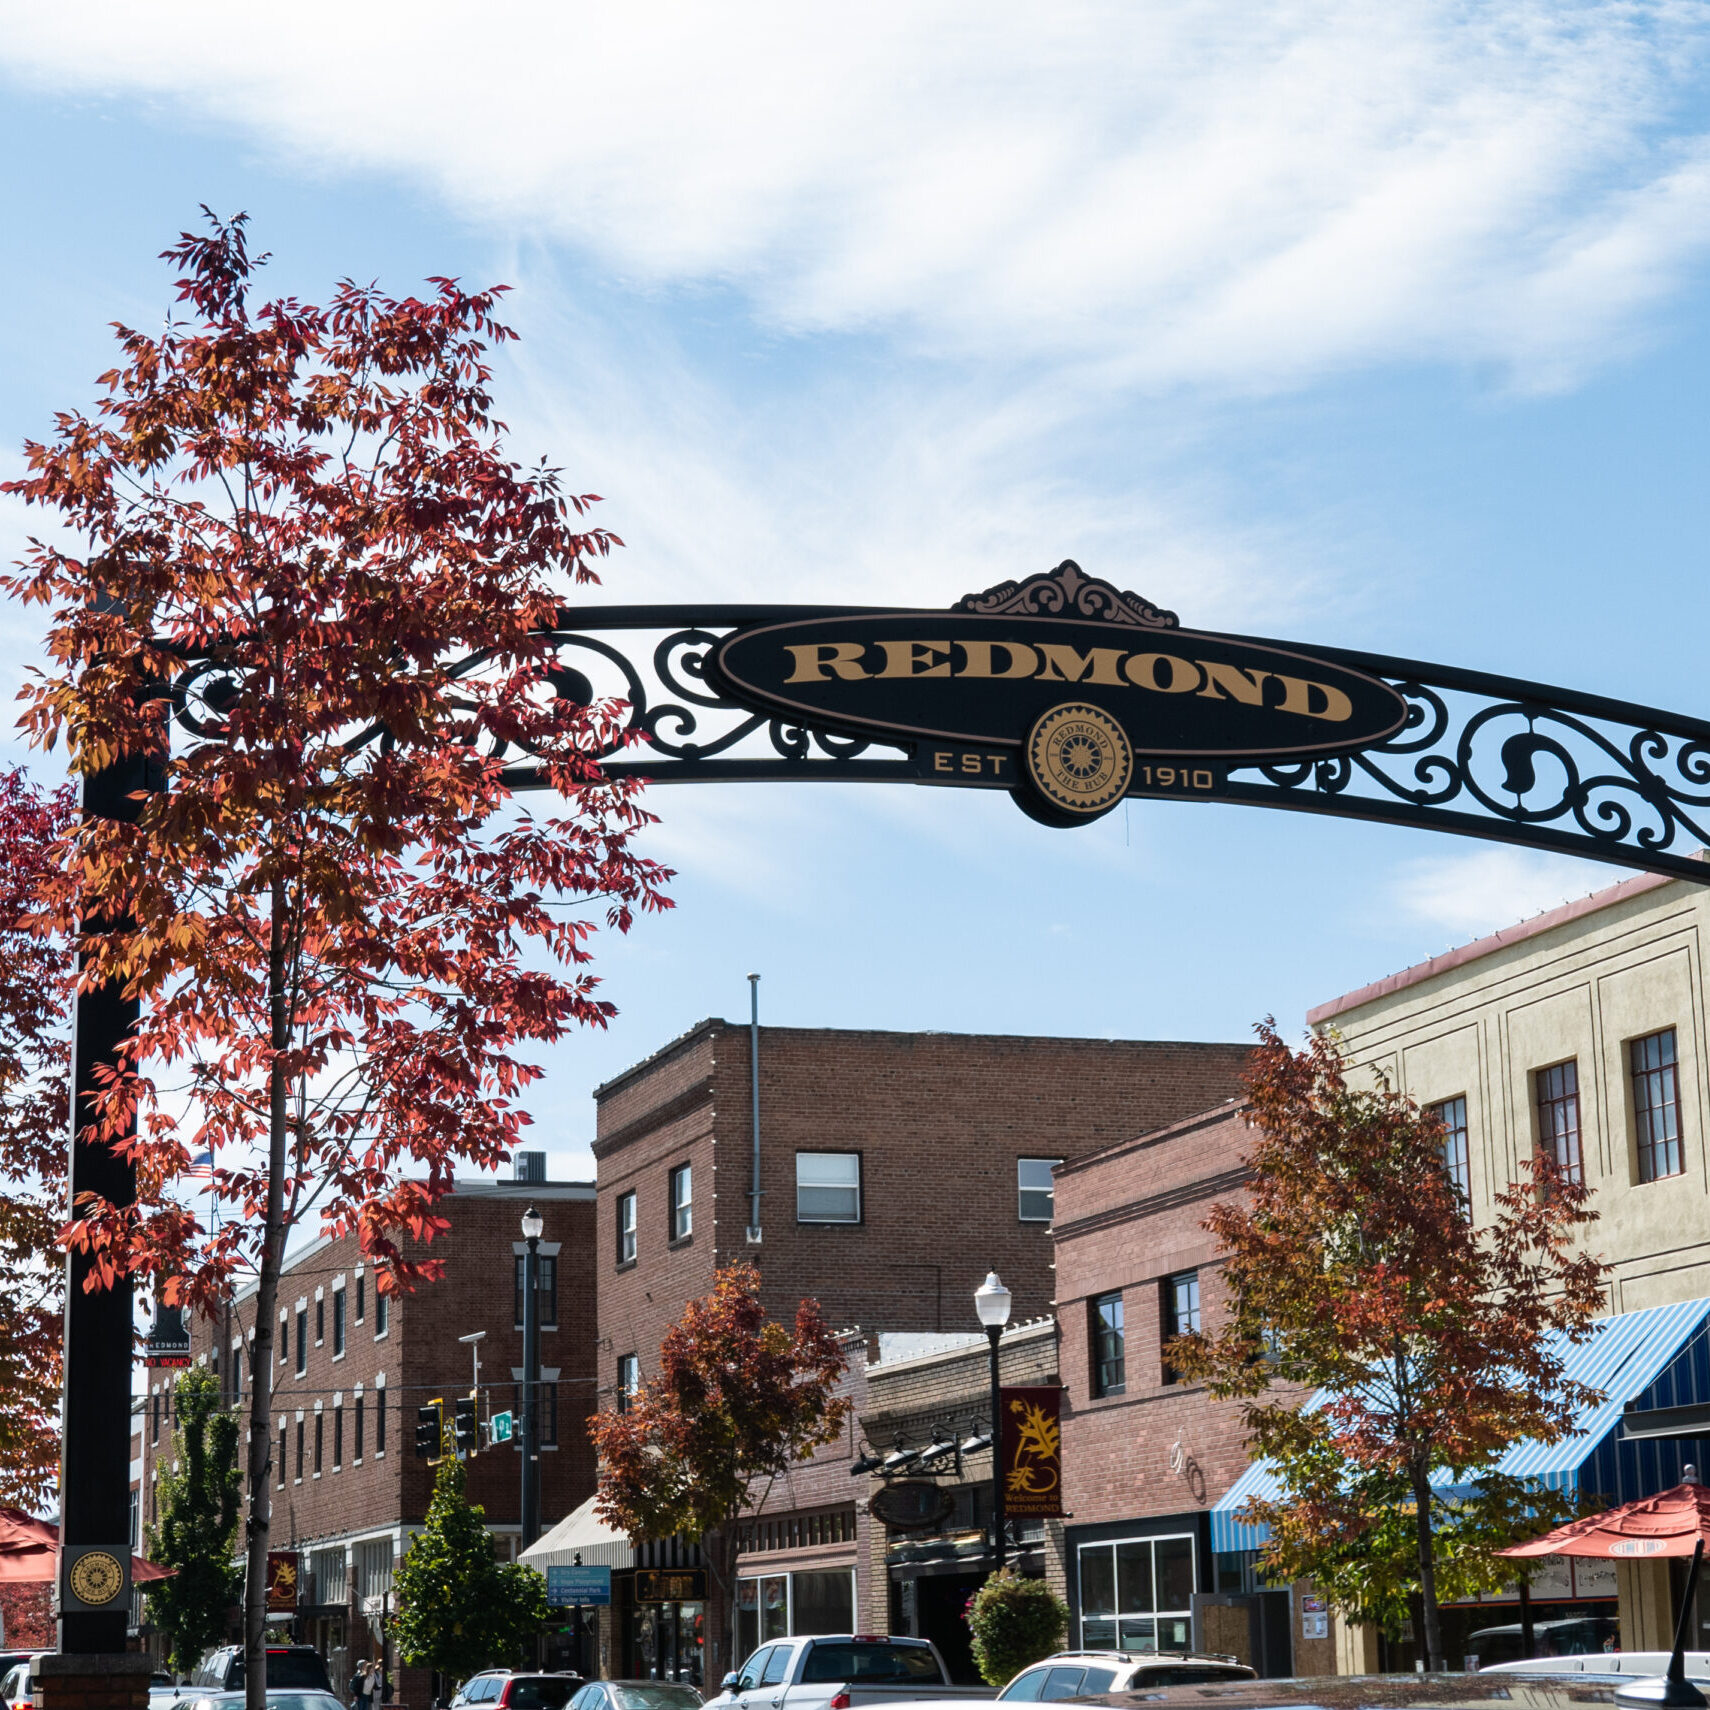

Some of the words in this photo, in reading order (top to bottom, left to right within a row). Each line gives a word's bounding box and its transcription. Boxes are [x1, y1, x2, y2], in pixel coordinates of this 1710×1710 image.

[783, 640, 1353, 722] REDMOND
[1053, 725, 1109, 748] REDMOND
[934, 752, 1007, 774] EST
[1057, 770, 1079, 789] THE
[1085, 772, 1108, 790] HUB
[1142, 766, 1213, 789] 1910
[160, 1358, 191, 1367] VACANCY
[1005, 1493, 1047, 1502] Welcome
[1005, 1504, 1059, 1513] REDMOND
